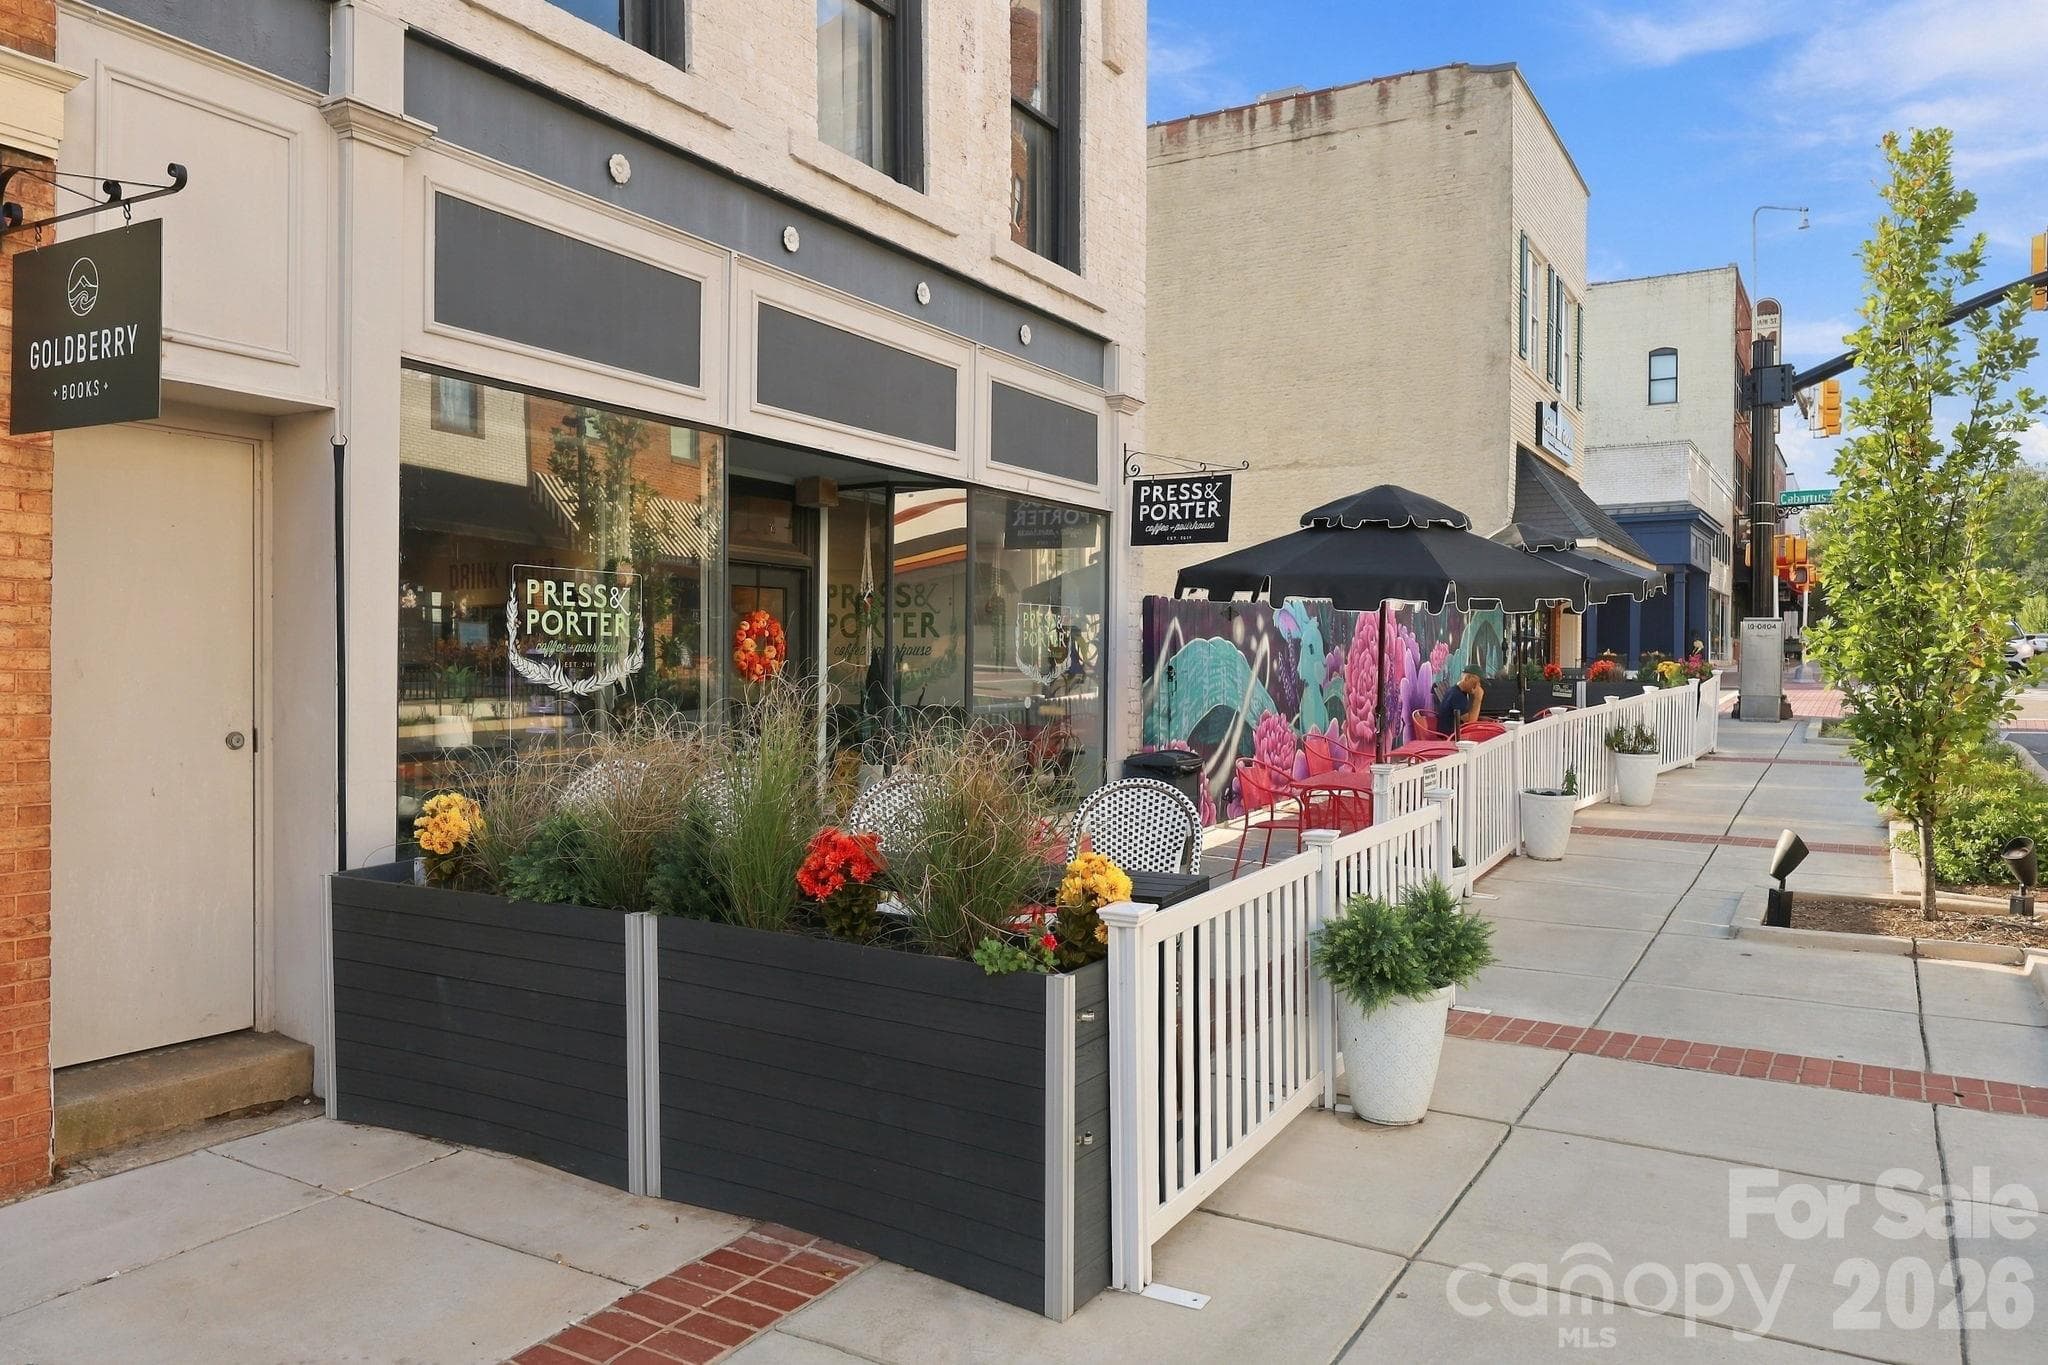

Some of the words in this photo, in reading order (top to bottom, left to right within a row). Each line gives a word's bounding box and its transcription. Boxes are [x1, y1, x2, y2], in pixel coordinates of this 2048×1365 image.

[30, 324, 138, 370] GOLDBERRY
[62, 380, 100, 400] BOOKS
[1780, 492, 1827, 506] Cabarrus
[1139, 501, 1221, 521] PORTER
[1145, 523, 1169, 535] coffee
[1172, 521, 1215, 534] pourhouse
[449, 562, 498, 590] DRINK
[526, 608, 631, 638] PORTER
[536, 640, 567, 658] coffee
